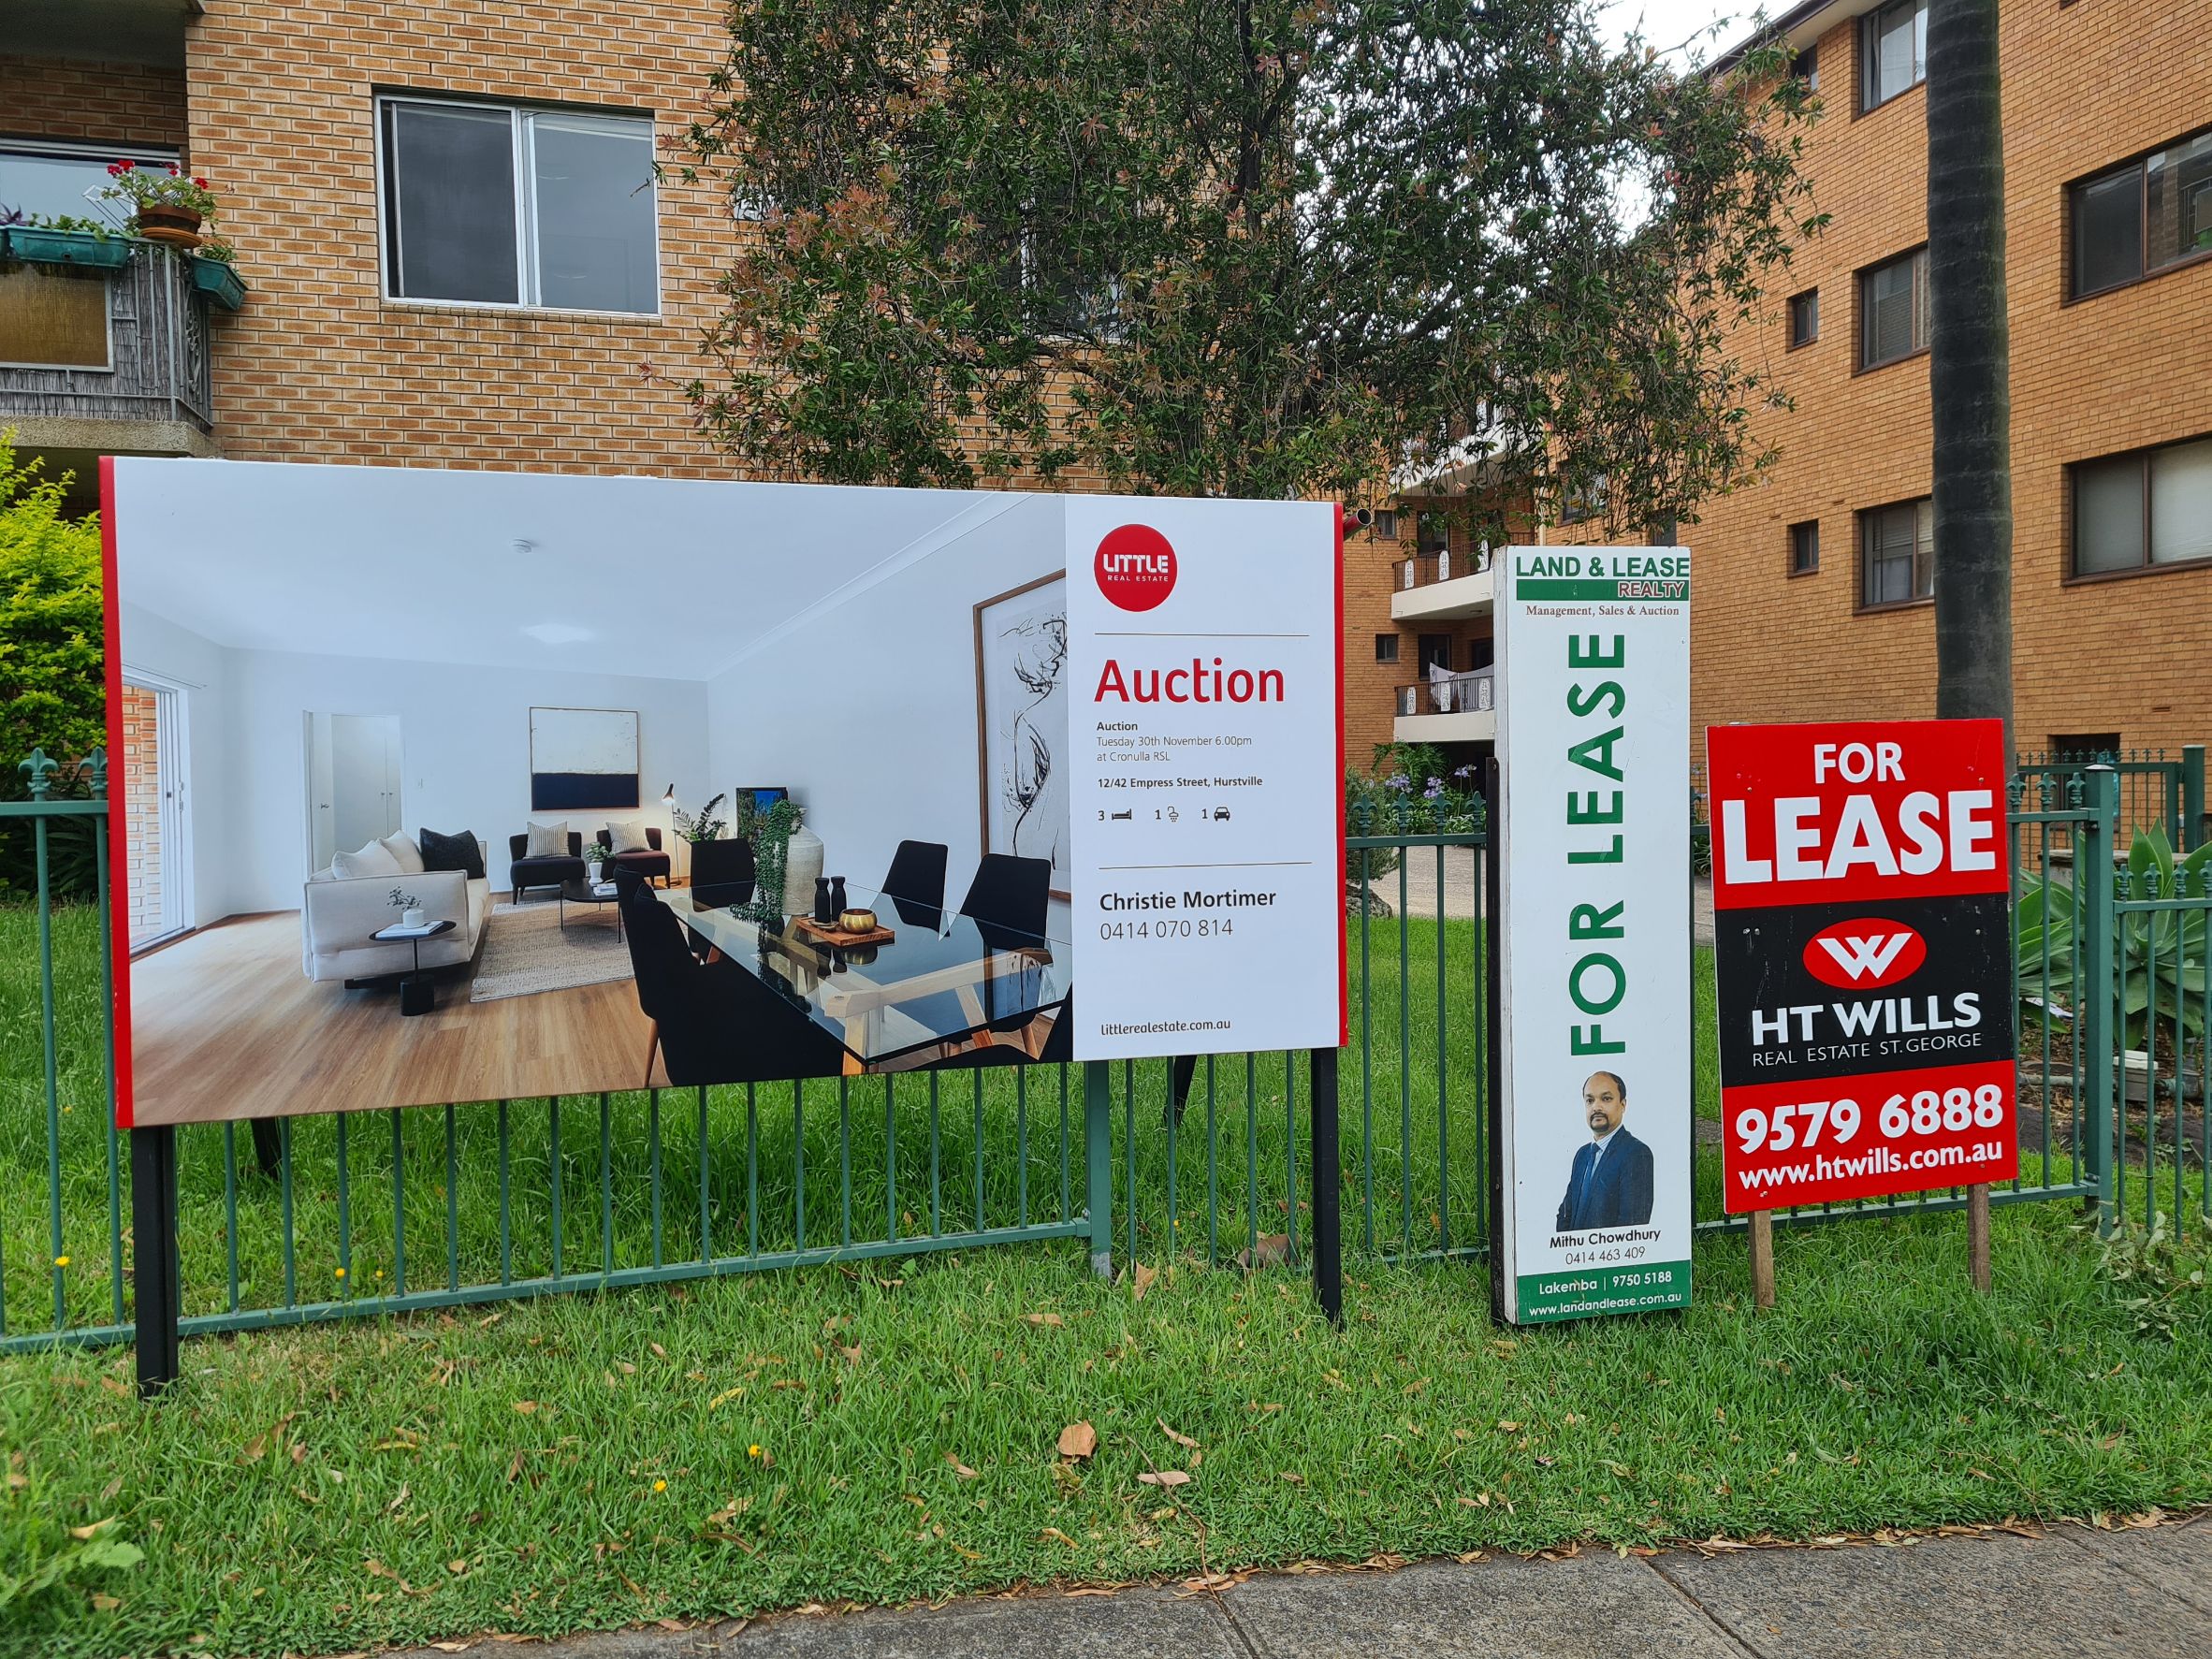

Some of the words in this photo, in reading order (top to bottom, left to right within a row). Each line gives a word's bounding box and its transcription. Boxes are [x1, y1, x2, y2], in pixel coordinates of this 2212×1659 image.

[1102, 553, 1169, 574] LITTLE
[1516, 556, 1581, 577] LAND
[1588, 556, 1606, 577] &
[1612, 557, 1690, 577] LEASE
[1618, 582, 1684, 598] REALTY
[1526, 605, 1595, 618] Management,
[1598, 605, 1624, 616] Sales
[1626, 605, 1637, 616] &
[1639, 605, 1680, 616] Auction
[1094, 657, 1285, 703] Auction
[1097, 721, 1138, 732] Auction
[1097, 736, 1135, 749] Tuesday
[1138, 736, 1160, 747] 30th
[1163, 735, 1213, 747] November
[1215, 735, 1252, 749] 6.00pm
[1566, 633, 1626, 865] LEASE
[1097, 752, 1107, 762] at
[1110, 751, 1151, 762] Cronulla
[1154, 751, 1170, 762] RSL
[1813, 742, 1906, 784] FOR
[1098, 778, 1127, 788] 12/42
[1130, 777, 1173, 789] Empress
[1176, 777, 1211, 788] Street,
[1214, 776, 1263, 786] Hurstville
[1098, 810, 1105, 822] 3
[1155, 809, 1161, 820] 1
[1201, 808, 1208, 820] 1
[1722, 789, 1996, 884] LEASE
[1099, 891, 1176, 911] Christie
[1183, 889, 1276, 909] Mortimer
[1099, 921, 1149, 940] 0414
[1155, 920, 1191, 938] 070
[1198, 918, 1233, 937] 814
[1568, 900, 1626, 1055] FOR
[1100, 1019, 1231, 1036] littlerealestate.com.au
[1752, 1005, 1824, 1045] HT
[1832, 992, 1982, 1038] WILLS
[1753, 1050, 1798, 1067] REAL
[1807, 1042, 1870, 1061] ESTATE
[1736, 1099, 1861, 1154] 9579
[1879, 1084, 2003, 1139] 6888
[1739, 1142, 2002, 1189] www.htwills.com.au
[1550, 1231, 1584, 1248] Mithu
[1588, 1229, 1661, 1245] Chowdhury
[1565, 1250, 1595, 1265] 0414
[1598, 1248, 1621, 1260] 463
[1624, 1246, 1646, 1259] 409
[1539, 1279, 1597, 1295] Lakemba
[1612, 1273, 1641, 1288] 9750
[1644, 1271, 1672, 1285] 5188
[1529, 1292, 1681, 1317] www.landandlease.com.au
